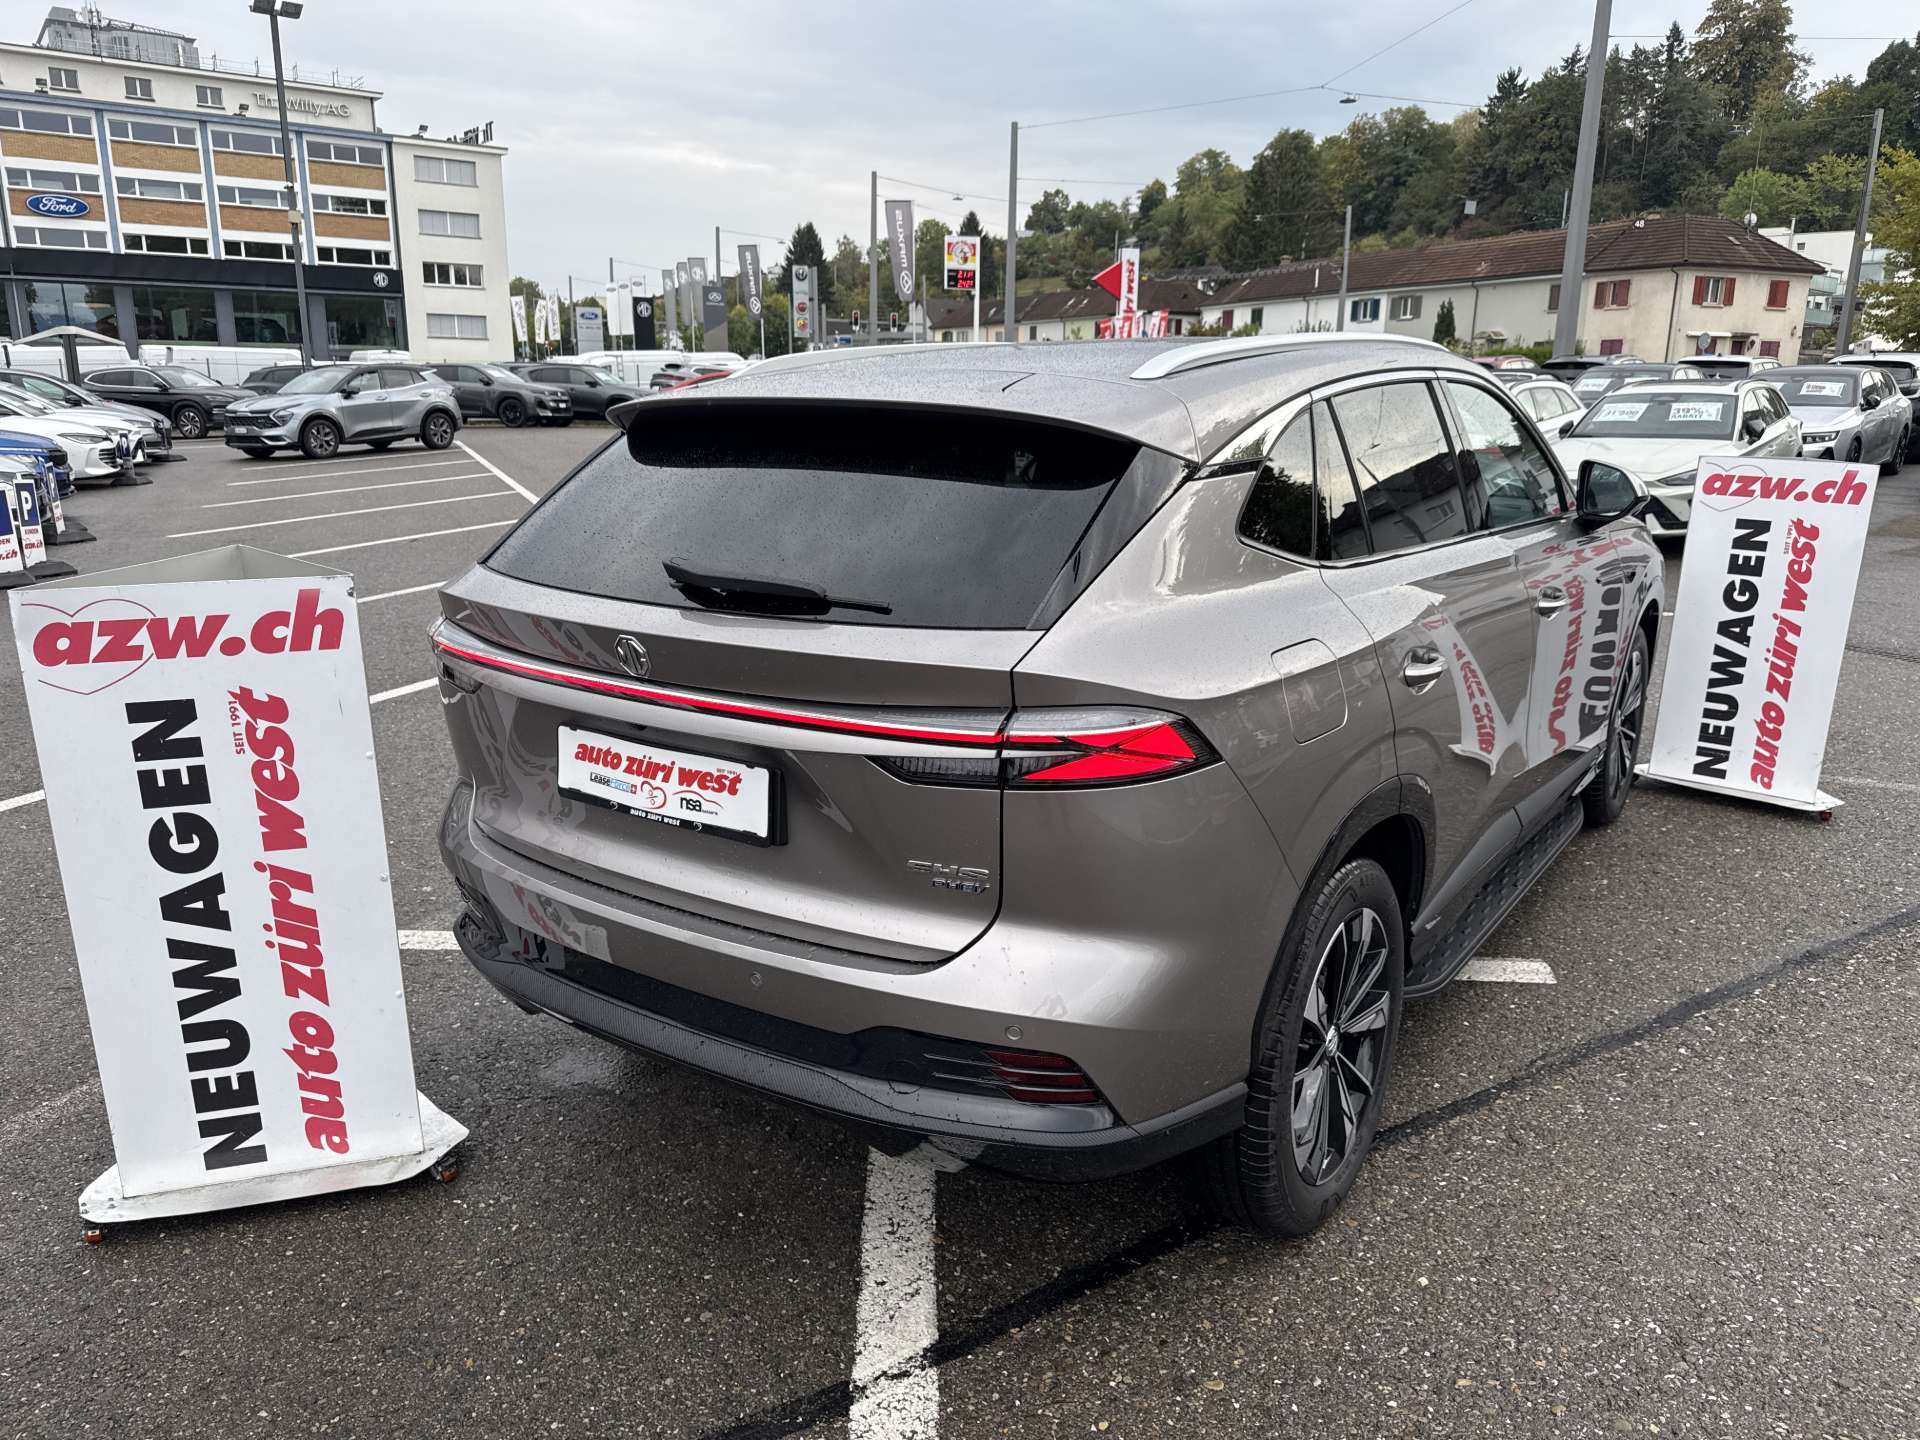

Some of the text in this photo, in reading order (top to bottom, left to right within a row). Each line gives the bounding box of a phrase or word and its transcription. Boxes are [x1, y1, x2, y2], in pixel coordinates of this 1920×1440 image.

[326, 103, 351, 118] AG
[39, 196, 77, 214] Ford
[636, 301, 652, 318] MG
[20, 490, 32, 520] P
[1702, 470, 1868, 505] azw.ch
[32, 588, 345, 667] azw.ch
[1692, 518, 1772, 780] NEUWAGEN
[1750, 518, 1819, 790] auto züri west
[228, 700, 245, 755] SEIT 1991
[574, 743, 743, 796] auto züri west
[680, 796, 702, 812] nsa
[124, 698, 269, 1172] NEUWAGEN
[226, 686, 351, 1155] auto züri west
